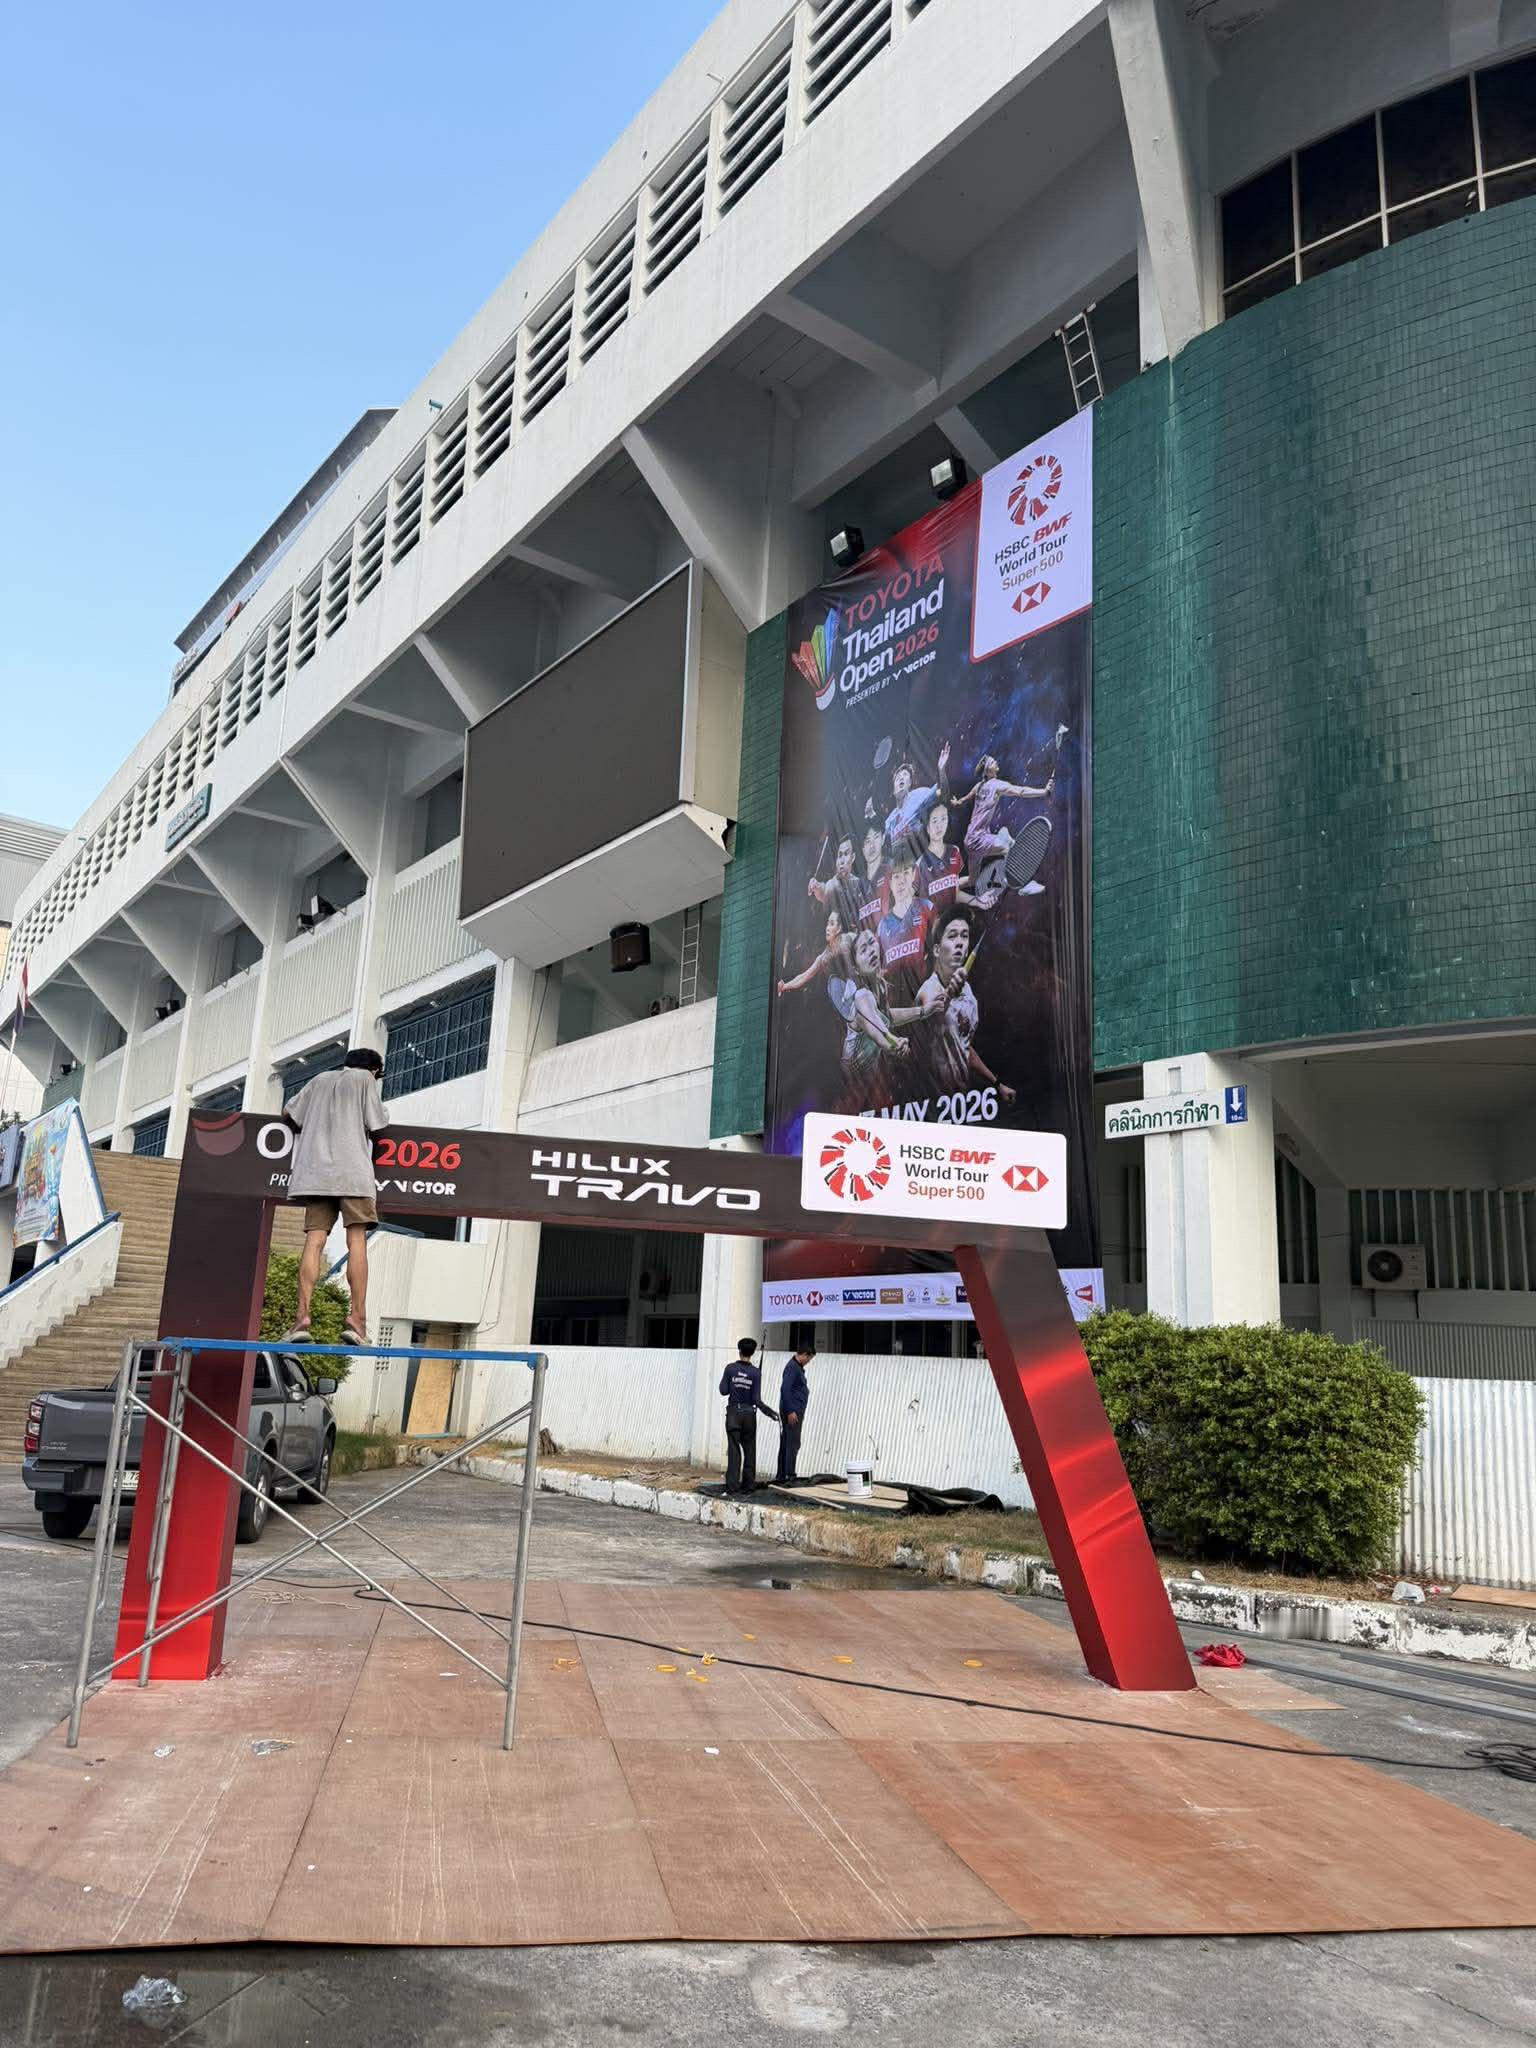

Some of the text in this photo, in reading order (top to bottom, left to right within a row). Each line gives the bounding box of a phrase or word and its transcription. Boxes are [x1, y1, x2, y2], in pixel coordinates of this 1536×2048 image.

[995, 511, 1072, 565] HSBC BWF
[999, 533, 1068, 577] World Tour
[1002, 550, 1063, 591] Super 500
[845, 552, 944, 630] TOYOTA
[843, 577, 944, 664] Thailand
[839, 620, 939, 693] Open 2026
[904, 650, 937, 674] VICTOR
[887, 941, 920, 961] TOYOTA
[936, 1087, 998, 1125] 2026
[1108, 1100, 1220, 1132] คลินิกการกีฬา
[375, 1139, 461, 1170] 2026
[531, 1149, 671, 1177] HILUX
[900, 1144, 996, 1165] HSBC BWF
[394, 1180, 457, 1195] VICTOR
[905, 1163, 989, 1182] World Tour
[530, 1173, 761, 1211] TRAVO
[907, 1181, 985, 1200] Super 500
[769, 1294, 804, 1306] TOYOTA
[851, 1290, 875, 1300] VICTOR
